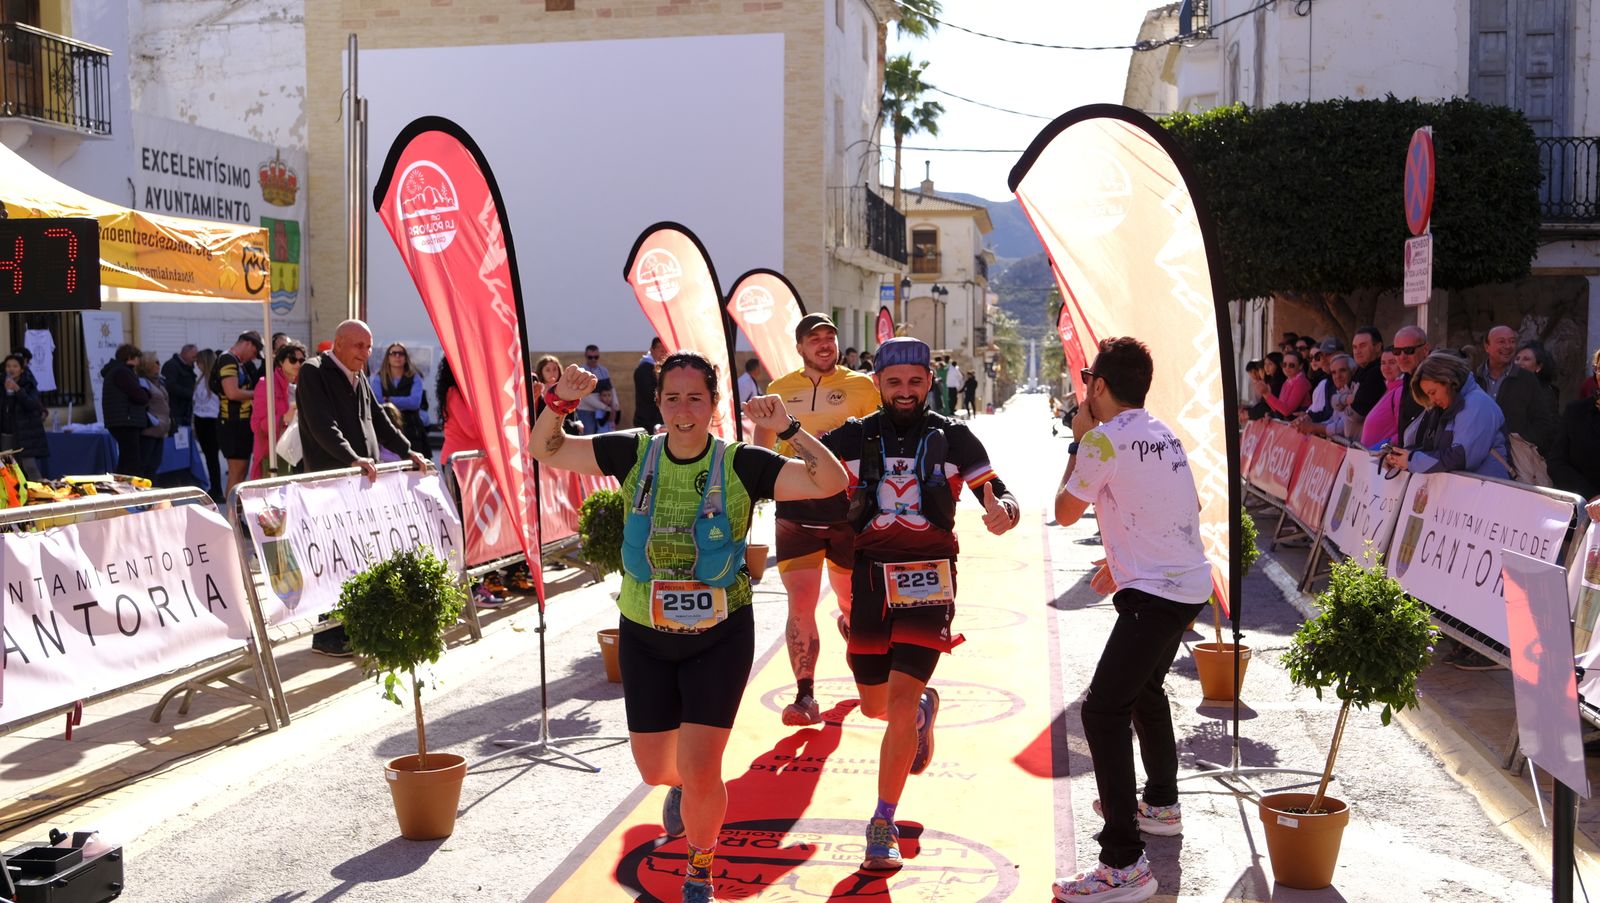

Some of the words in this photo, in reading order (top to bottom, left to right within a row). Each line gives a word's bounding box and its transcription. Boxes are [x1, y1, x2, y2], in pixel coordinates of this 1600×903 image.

[142, 147, 250, 190] EXCELENTÍSIMO
[145, 186, 250, 222] AYUNTAMIENTO
[301, 502, 420, 535] AYUNTAMIENTO
[1434, 506, 1528, 551] AYUNTAMIENTO
[1530, 536, 1550, 560] DE
[183, 543, 210, 567] DE
[897, 571, 939, 588] 229
[663, 592, 713, 611] 250
[719, 836, 866, 855] OLVOR
